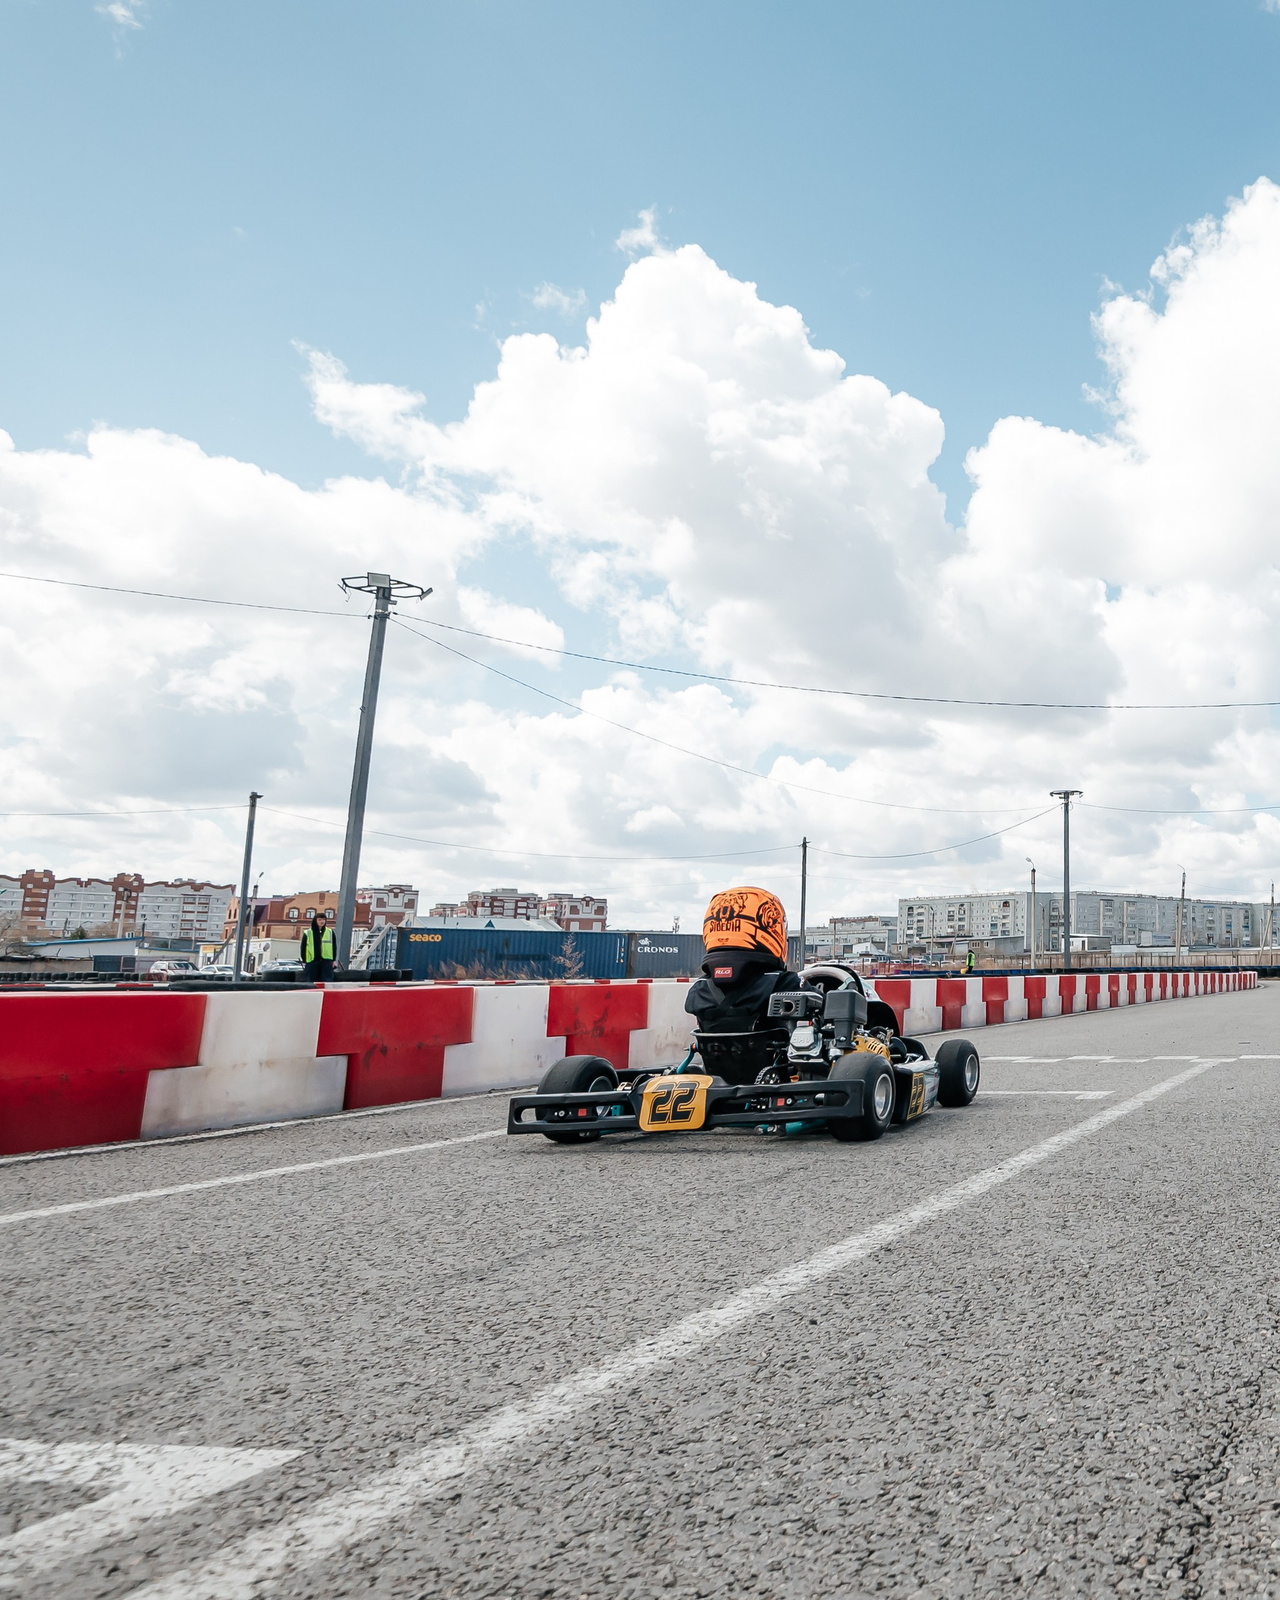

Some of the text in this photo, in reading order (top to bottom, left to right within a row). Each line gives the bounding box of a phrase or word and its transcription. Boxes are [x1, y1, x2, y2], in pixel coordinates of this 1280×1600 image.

[409, 932, 442, 943] seaco
[637, 946, 679, 954] CRONOS
[647, 1080, 700, 1126] 22
